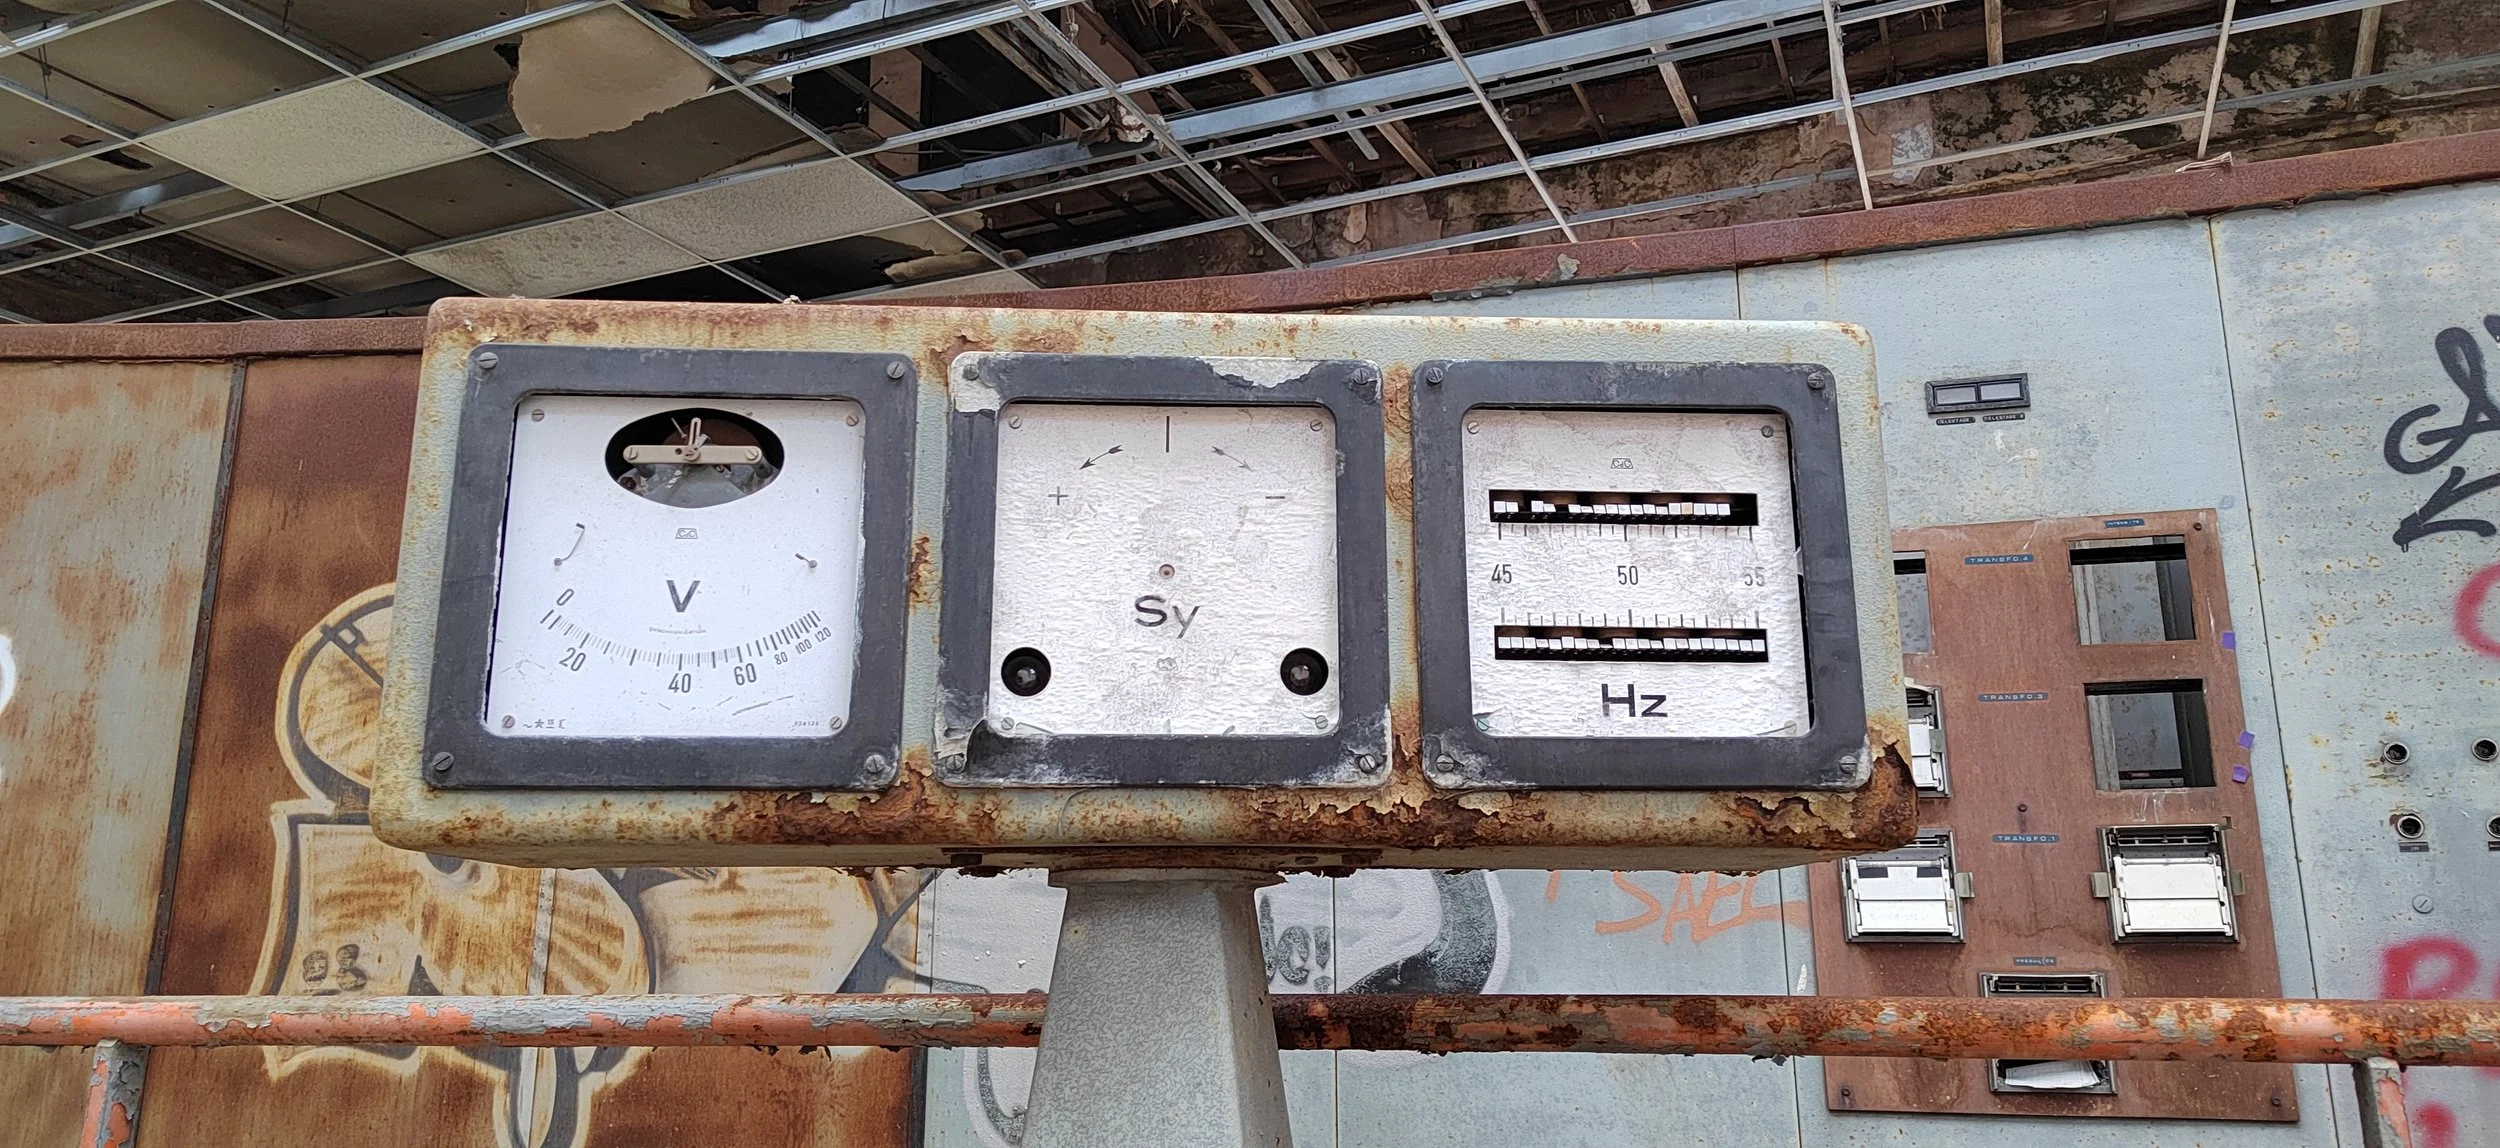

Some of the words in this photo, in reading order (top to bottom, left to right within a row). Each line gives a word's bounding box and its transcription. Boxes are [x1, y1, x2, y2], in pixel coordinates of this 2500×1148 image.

[1491, 564, 1512, 584] 45
[1617, 565, 1639, 586] 50
[1744, 566, 1765, 587] 55
[556, 588, 575, 606] 0
[666, 580, 700, 612] V
[1134, 594, 1200, 639] Sy
[814, 626, 832, 643] 120
[795, 638, 813, 654] 100
[558, 647, 586, 672] 20
[773, 651, 788, 665] 80
[668, 672, 692, 693] 40
[733, 662, 757, 686] 60
[1601, 683, 1668, 718] Hz
